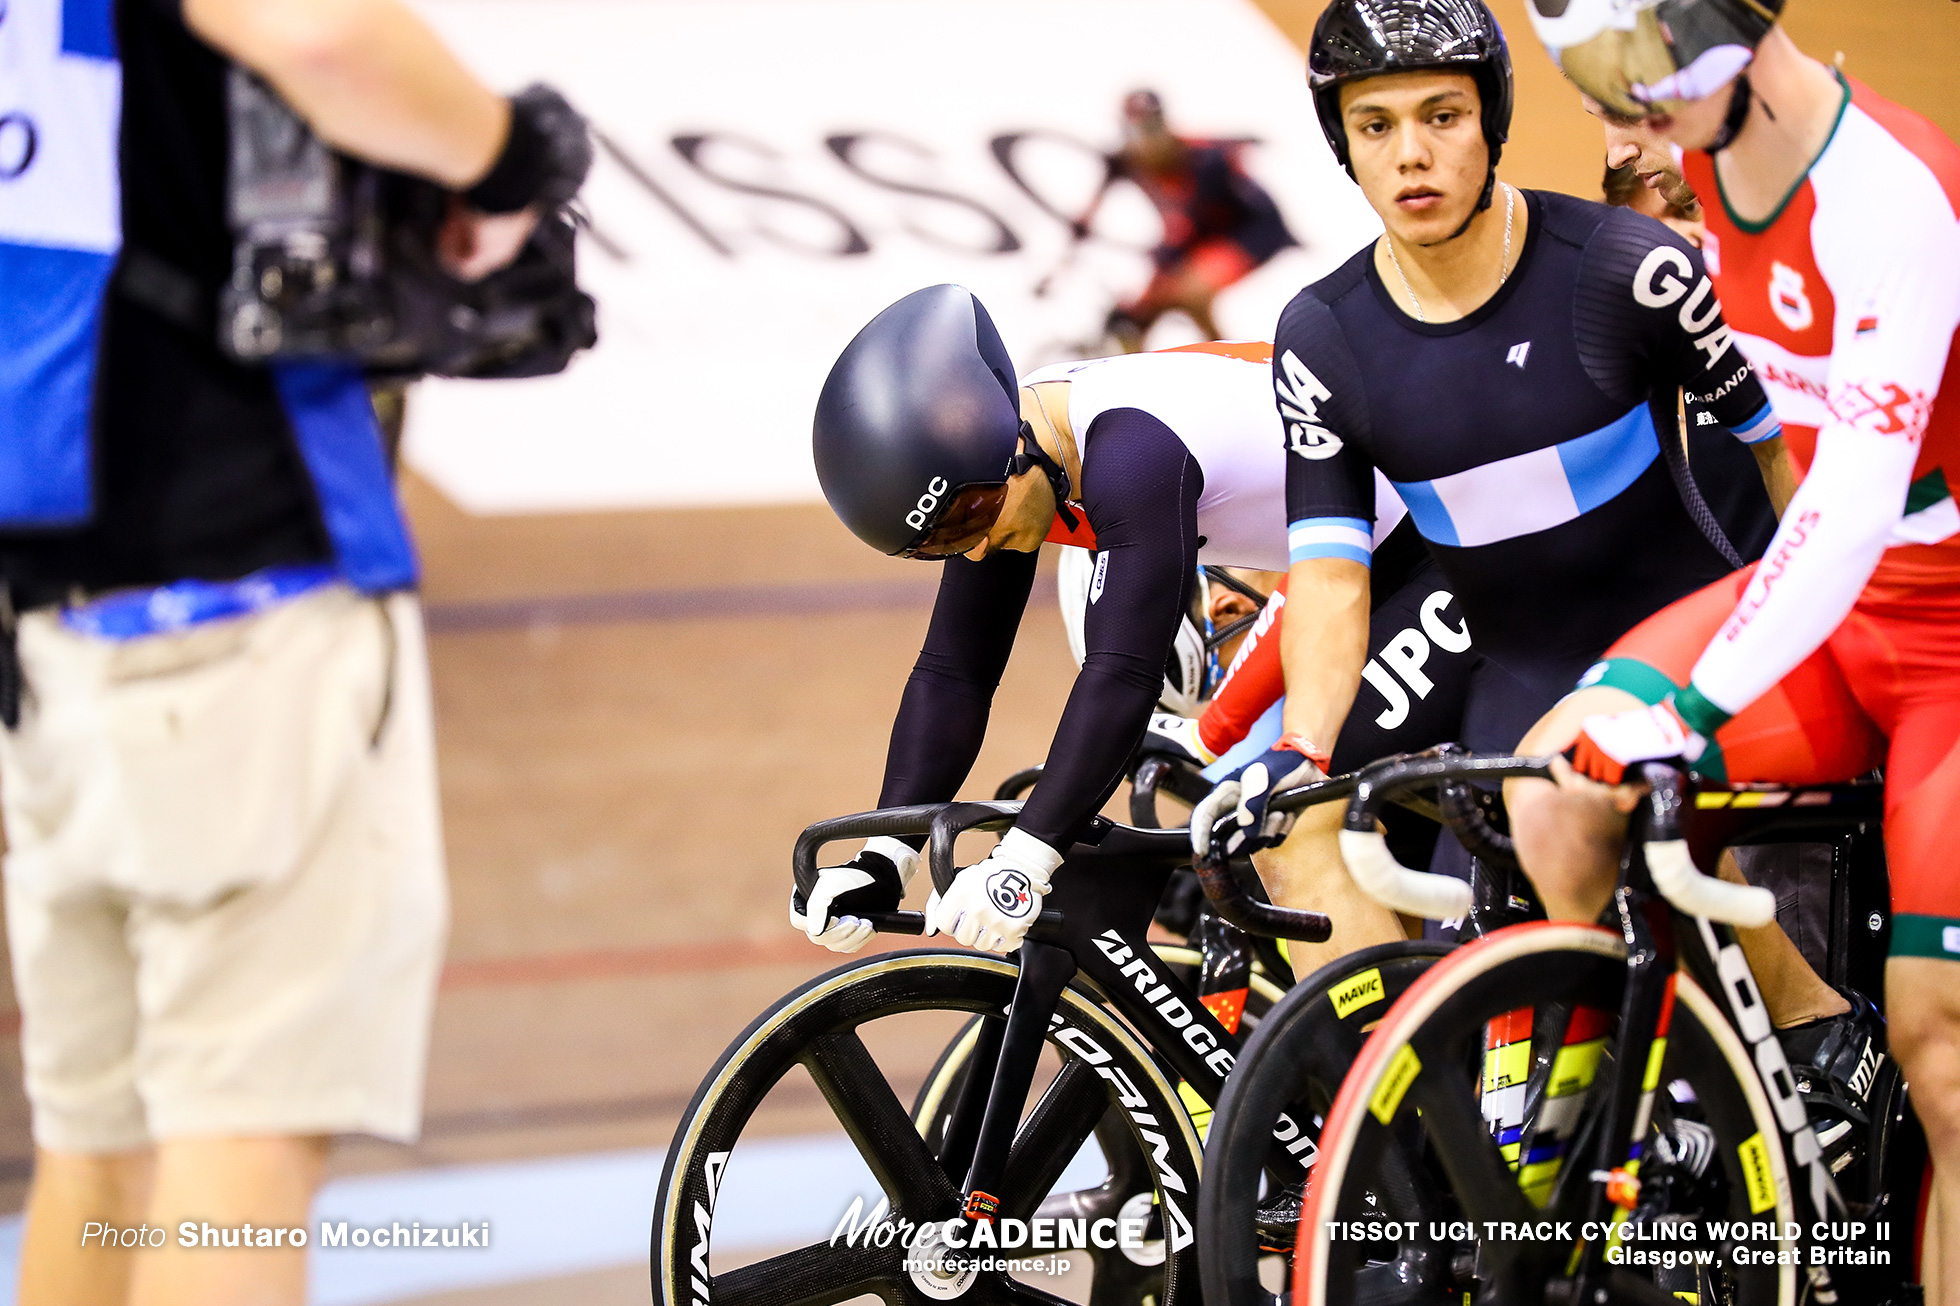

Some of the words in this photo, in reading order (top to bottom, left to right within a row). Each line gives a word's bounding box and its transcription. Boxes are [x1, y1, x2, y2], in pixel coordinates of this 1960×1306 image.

[1632, 245, 1737, 371] GUA
[1275, 348, 1344, 461] GUA
[1726, 510, 1821, 642] BELARUS
[1361, 590, 1472, 730] JPC
[1338, 978, 1379, 1008] MAVIC
